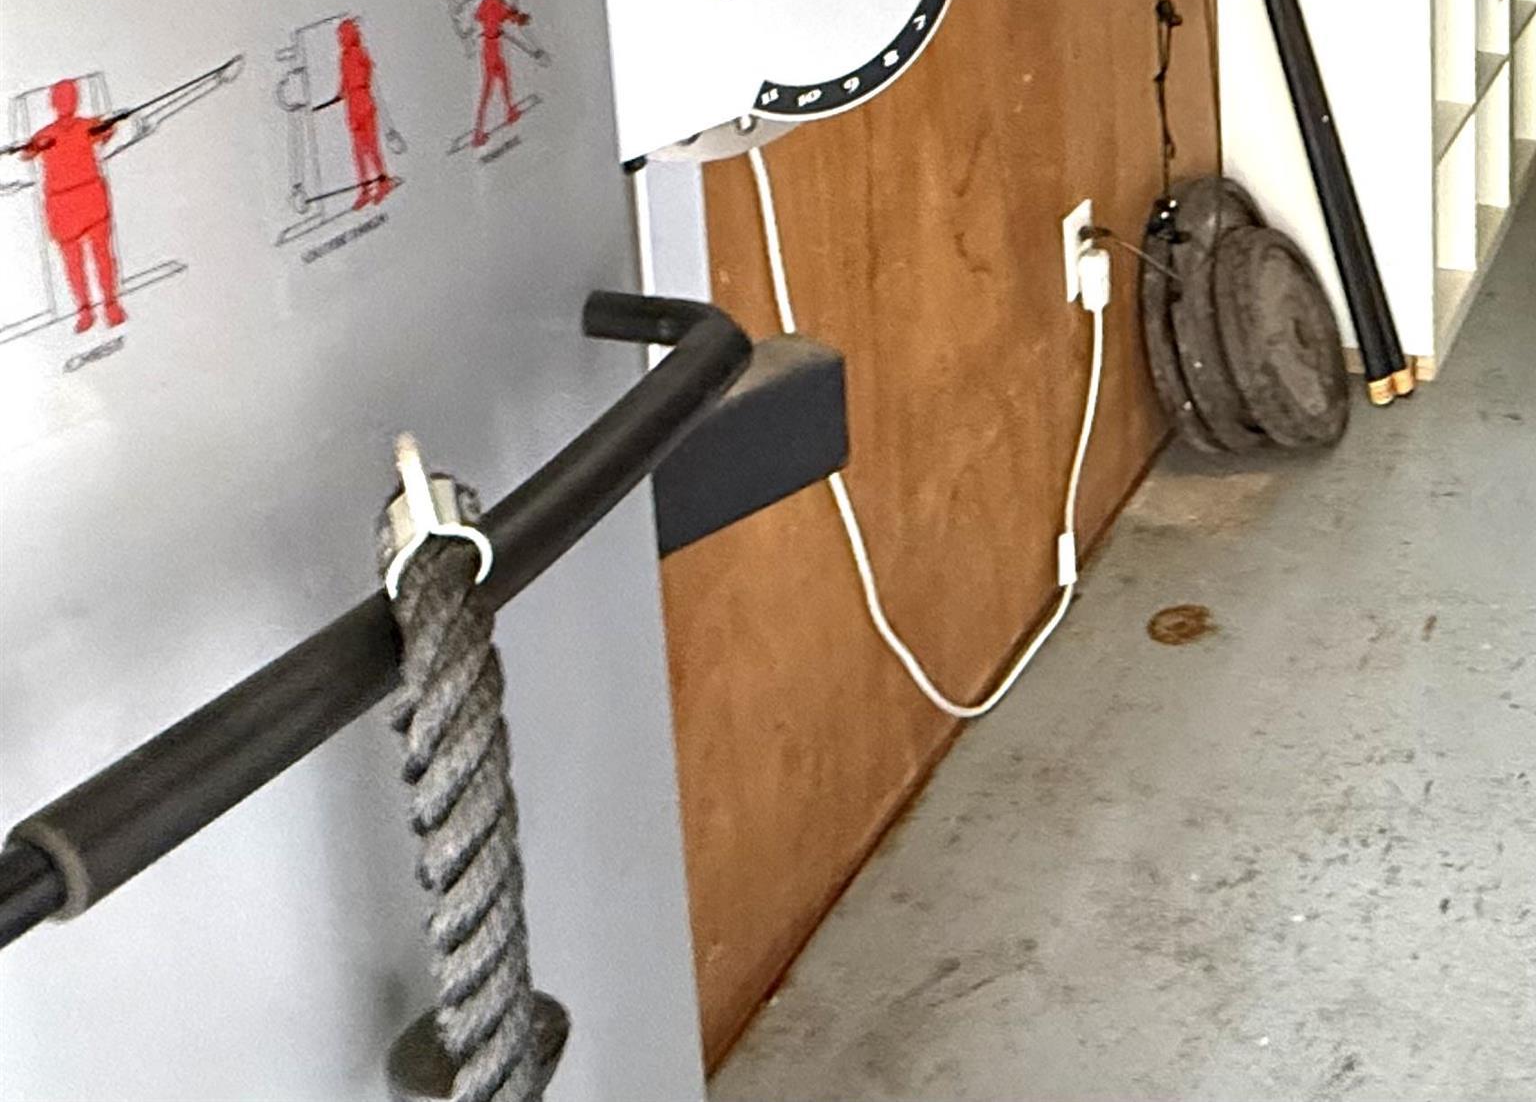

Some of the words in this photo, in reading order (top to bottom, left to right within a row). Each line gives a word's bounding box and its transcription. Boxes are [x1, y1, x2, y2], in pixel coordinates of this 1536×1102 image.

[913, 14, 927, 31] 7
[883, 49, 900, 67] 8
[843, 76, 860, 94] 9
[797, 88, 822, 107] 10
